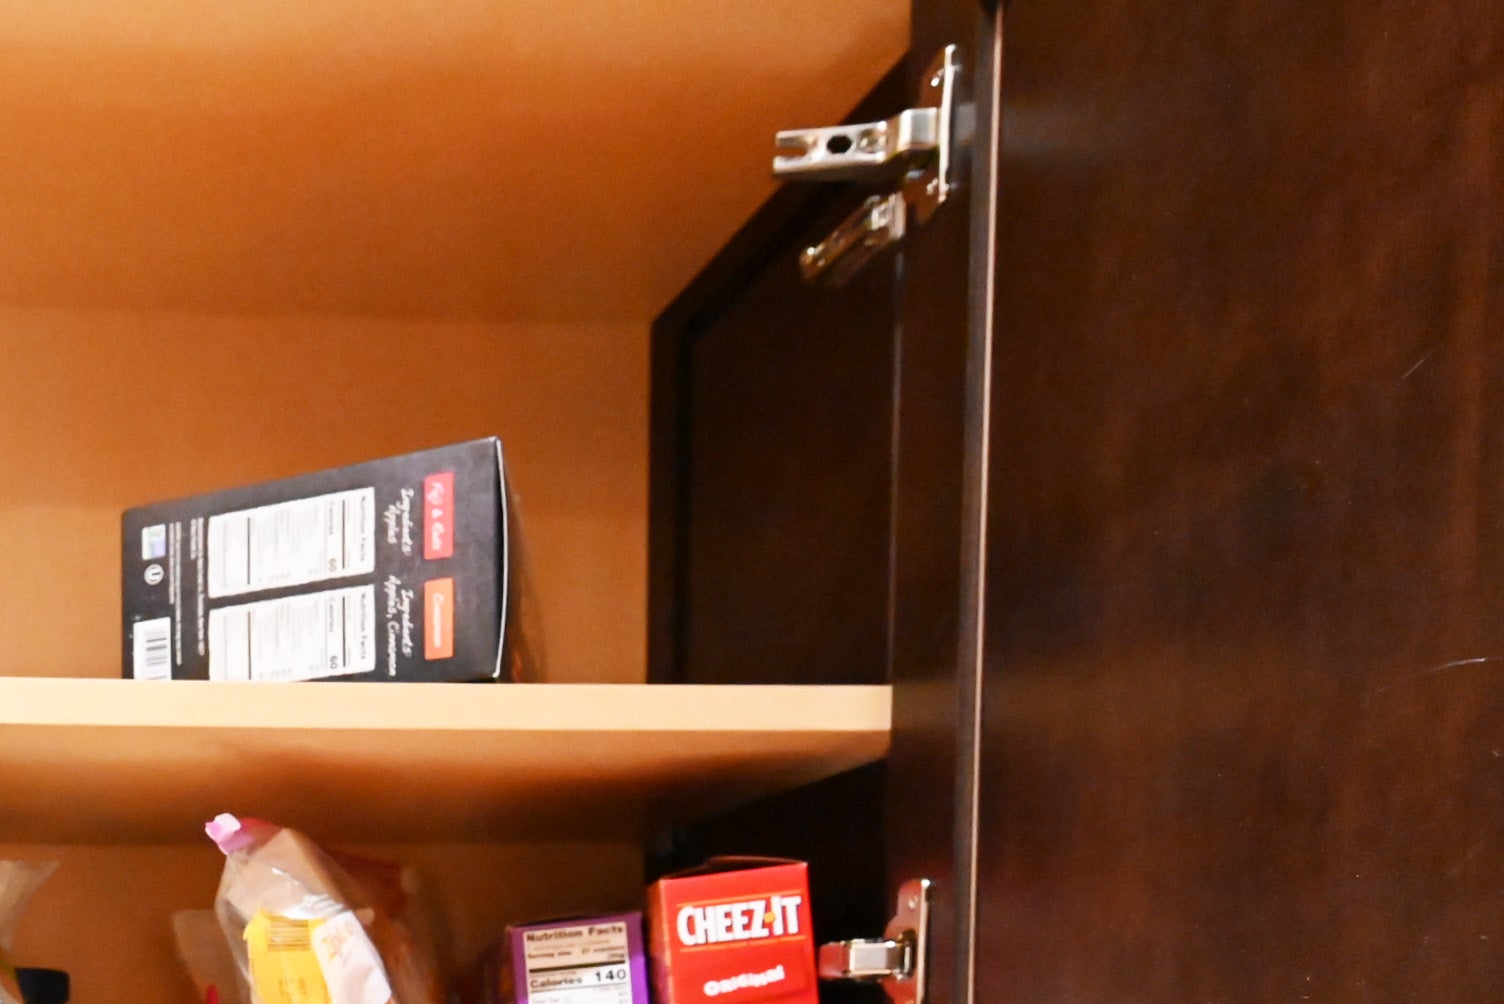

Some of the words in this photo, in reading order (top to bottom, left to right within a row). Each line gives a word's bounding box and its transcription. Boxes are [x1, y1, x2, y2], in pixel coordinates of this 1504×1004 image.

[677, 895, 802, 946] CHEEZ-IT
[526, 930, 583, 942] Nutrition
[588, 925, 623, 936] Facts
[530, 977, 583, 989] Calories
[595, 968, 626, 982] 140
